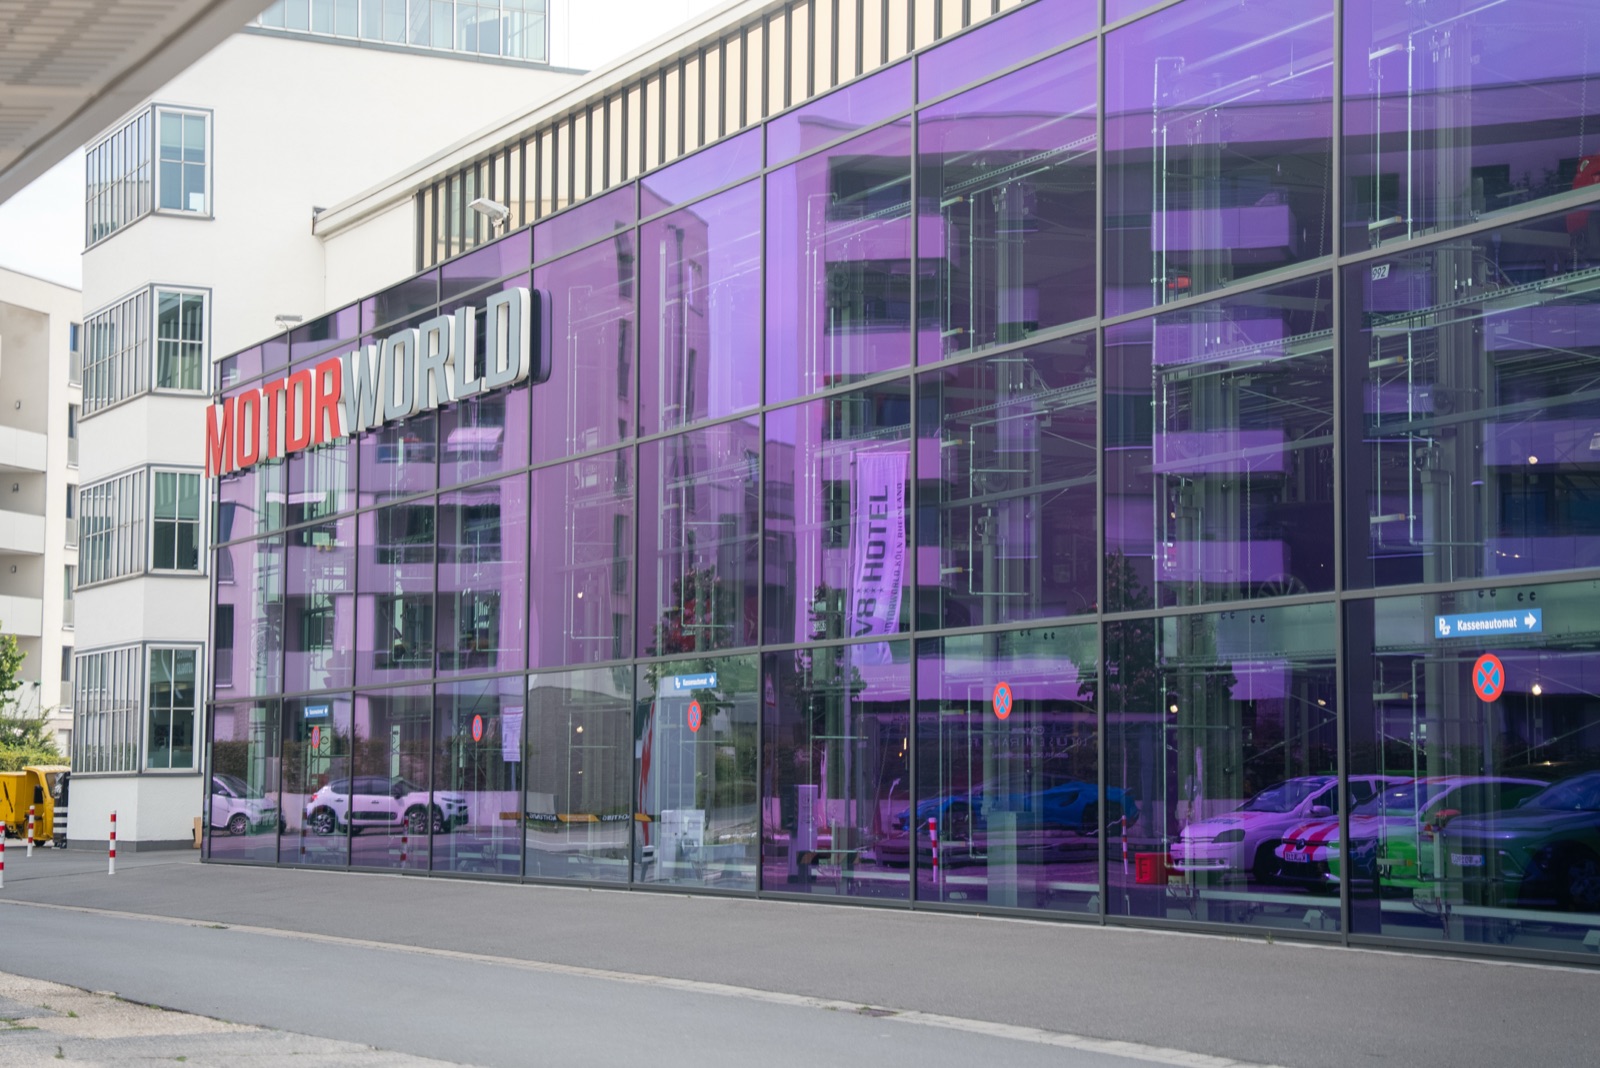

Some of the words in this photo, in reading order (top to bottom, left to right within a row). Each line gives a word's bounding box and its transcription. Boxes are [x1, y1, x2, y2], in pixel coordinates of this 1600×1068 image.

[205, 287, 529, 478] MOTORWORLD
[862, 485, 888, 582] HOTEL
[894, 542, 903, 567] KÖLN
[855, 598, 876, 636] V8
[1457, 616, 1517, 631] Kassenautomat
